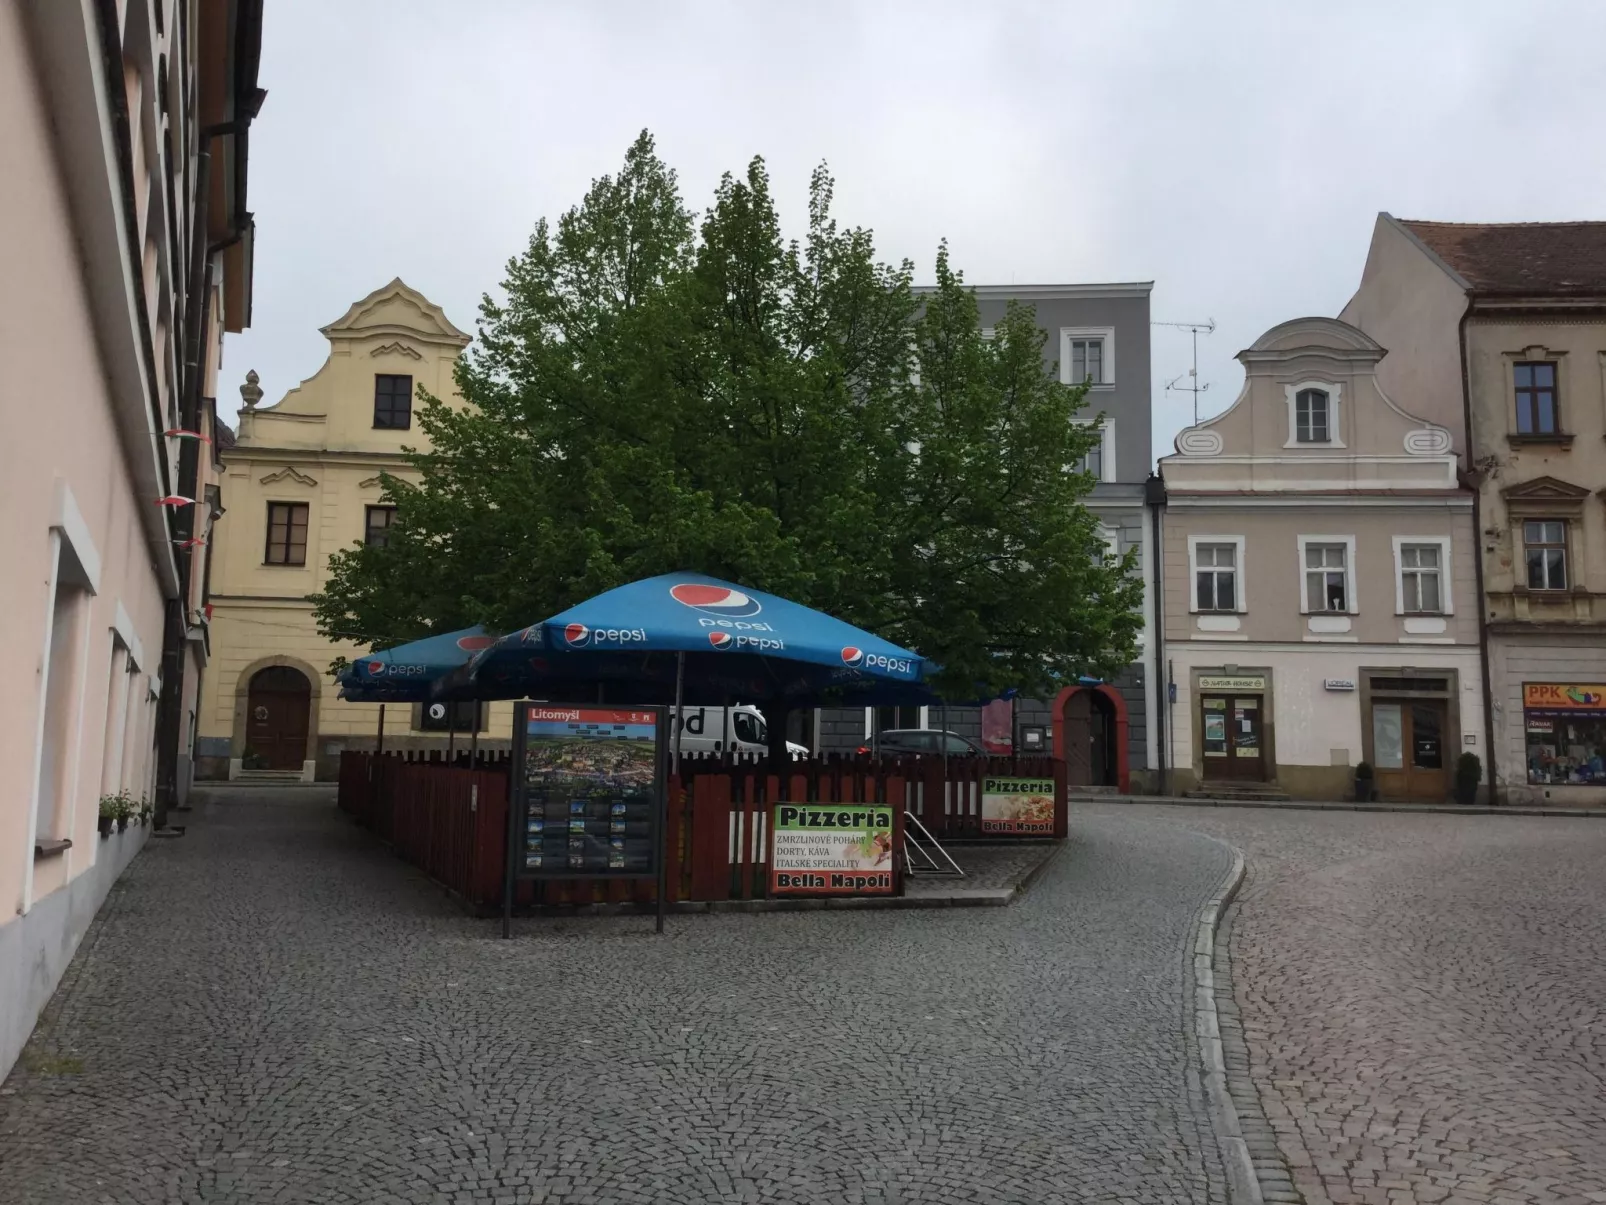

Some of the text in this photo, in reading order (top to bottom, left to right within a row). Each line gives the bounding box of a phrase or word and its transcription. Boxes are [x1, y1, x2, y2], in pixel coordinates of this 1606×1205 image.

[698, 617, 774, 632] pepsi
[594, 627, 646, 644] pepsi
[737, 634, 784, 650] pepsi
[866, 653, 911, 673] pepsi
[388, 664, 426, 677] pepsi
[1529, 686, 1560, 698] PPK
[532, 708, 579, 721] Litomyšl
[985, 780, 1053, 793] Pizzeria
[780, 807, 890, 827] Pizzeria
[984, 821, 1053, 832] Bella Napoli
[776, 834, 866, 845] ZMRZLINOVÉ POHÁRY
[776, 846, 830, 857] DORTY, KÁVA
[776, 859, 860, 868] ITALSKÉ SPECIALITY
[777, 873, 890, 889] Bella Napoli
